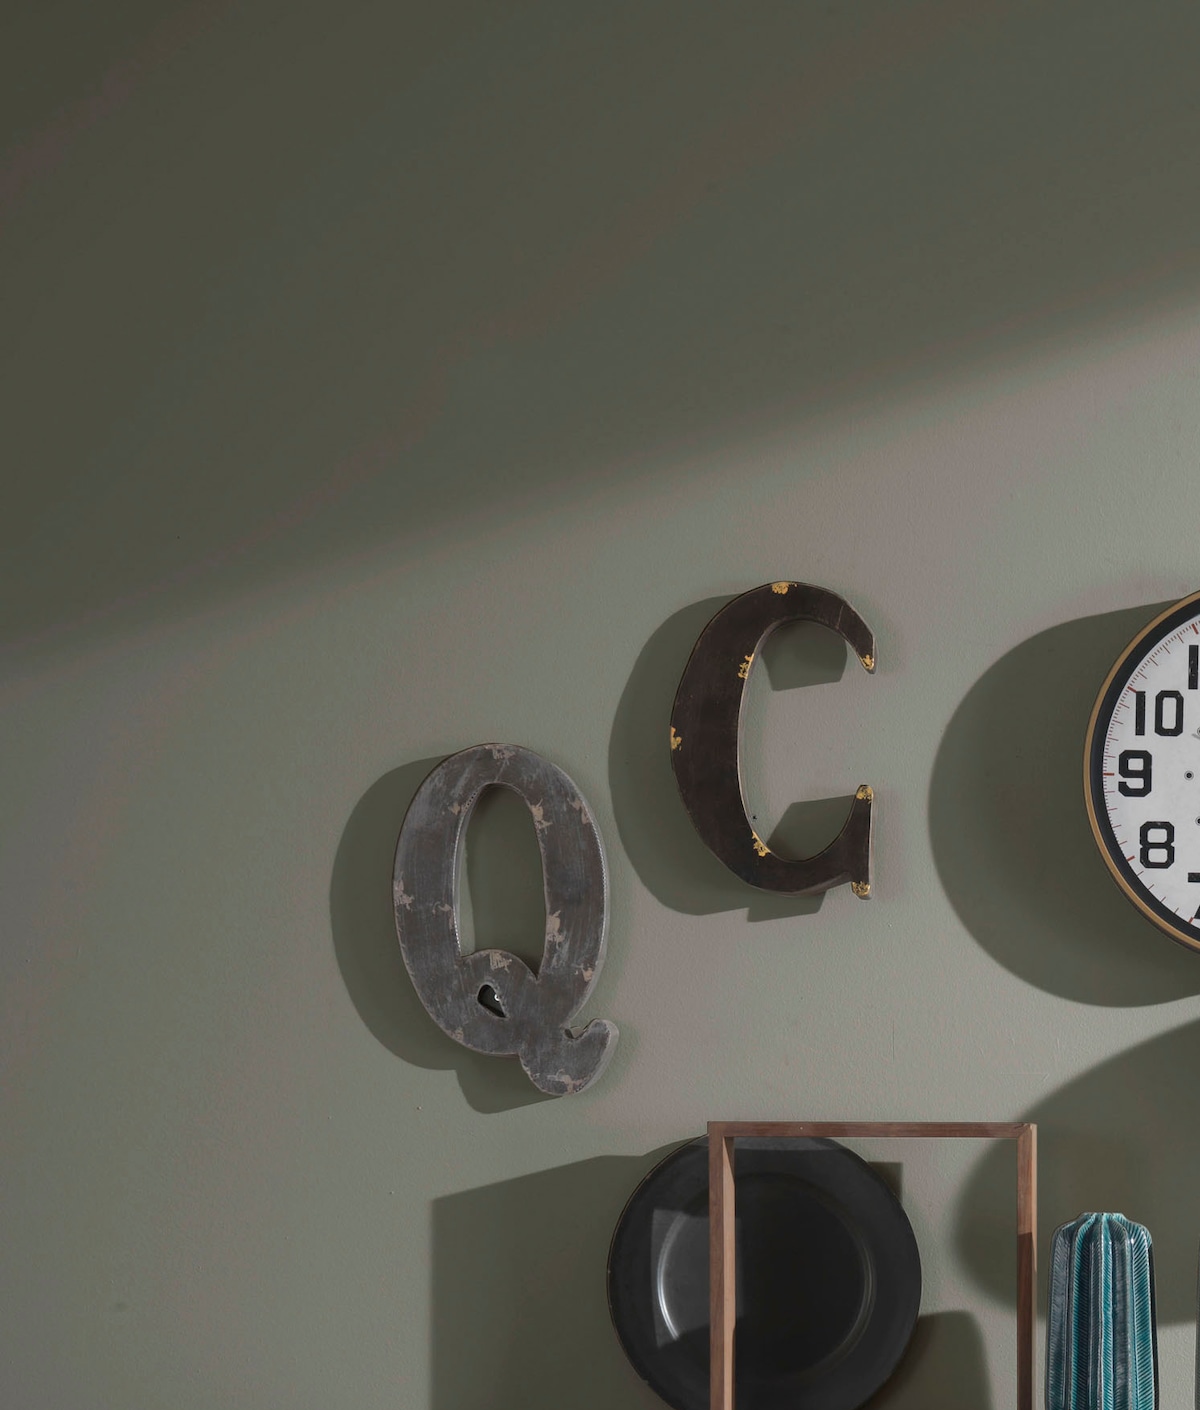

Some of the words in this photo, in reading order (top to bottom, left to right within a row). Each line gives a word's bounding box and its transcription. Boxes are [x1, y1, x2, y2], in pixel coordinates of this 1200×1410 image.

[1135, 690, 1184, 737] 10
[1118, 750, 1152, 797] 9
[1139, 821, 1175, 869] 8
[393, 743, 619, 1095] Q
